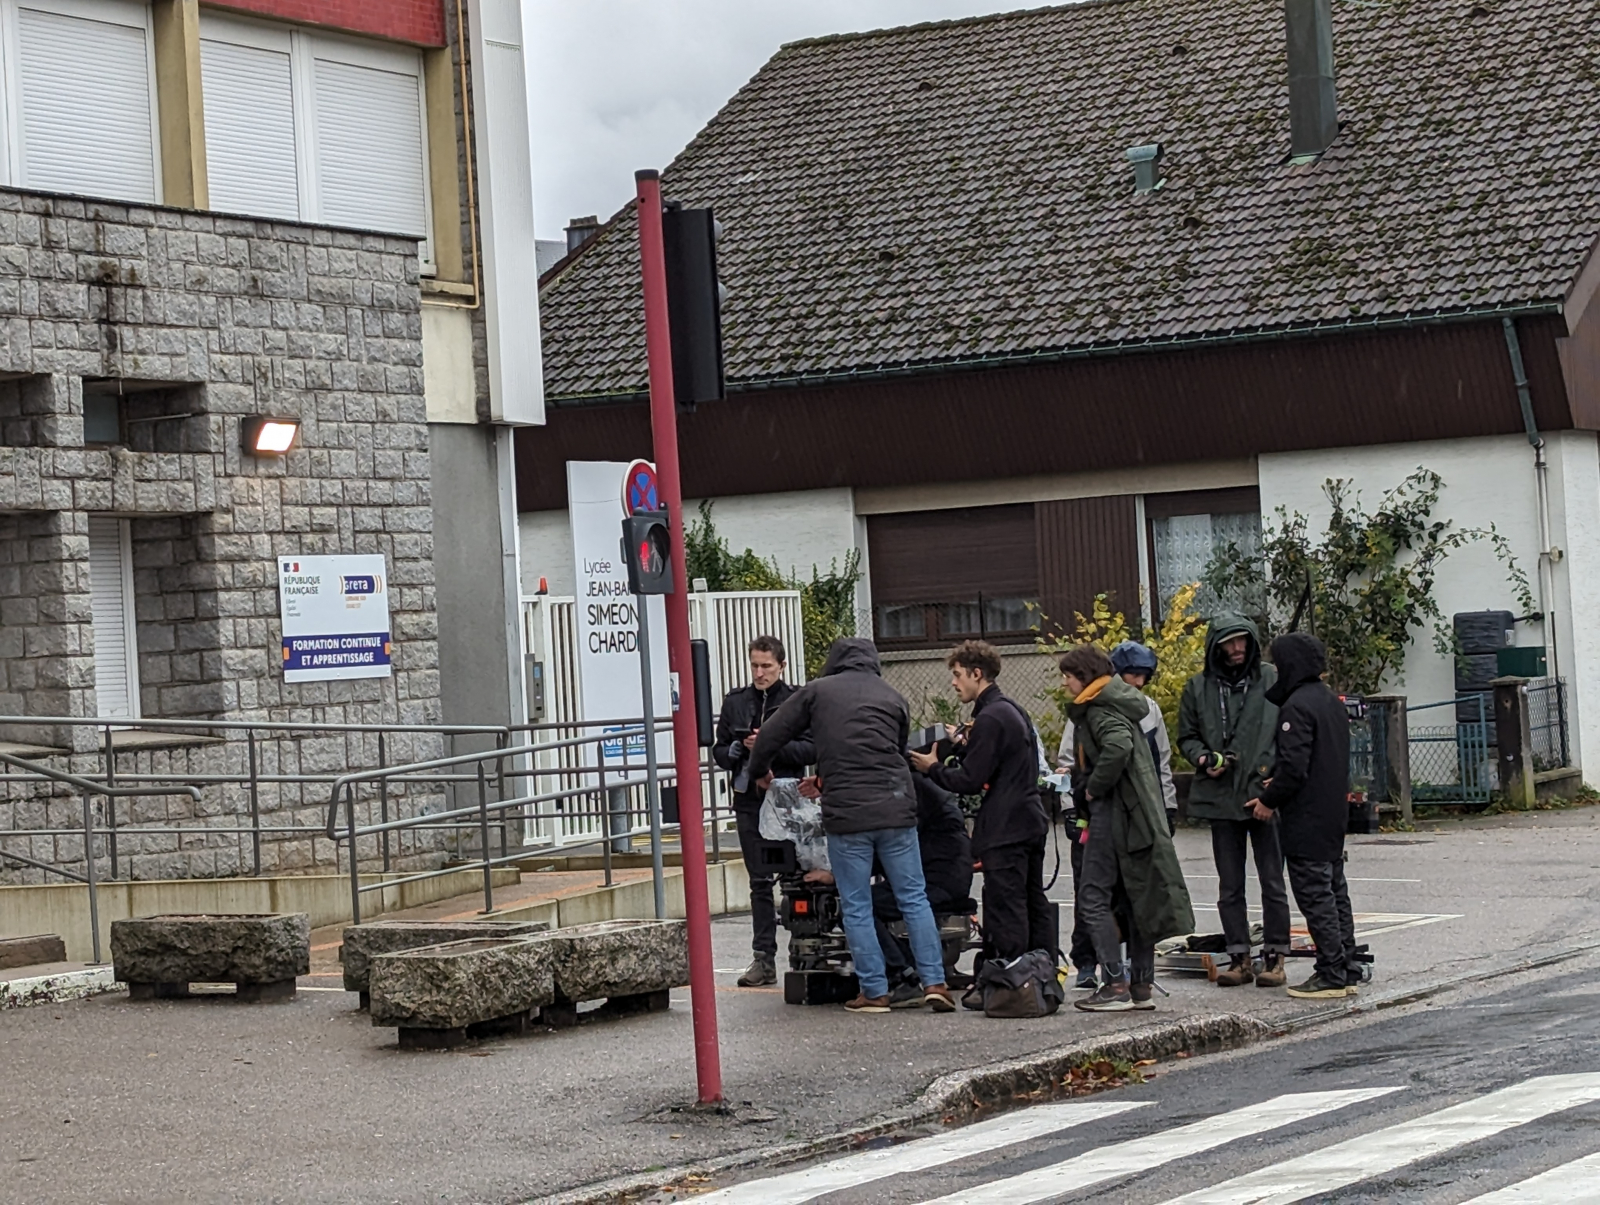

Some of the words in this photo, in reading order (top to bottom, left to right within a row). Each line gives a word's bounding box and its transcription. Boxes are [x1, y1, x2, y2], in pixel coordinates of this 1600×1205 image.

[584, 557, 611, 577] Lycée
[284, 575, 321, 585] RÉPUBLIQUE
[284, 586, 319, 596] FRANÇAISE
[586, 581, 629, 596] JEAN-BA
[588, 598, 639, 625] SIMÉON
[293, 640, 339, 650] FORMATION
[341, 637, 381, 648] CONTINUE
[301, 655, 311, 666] ET
[312, 652, 374, 665] APPRENTISSAGE
